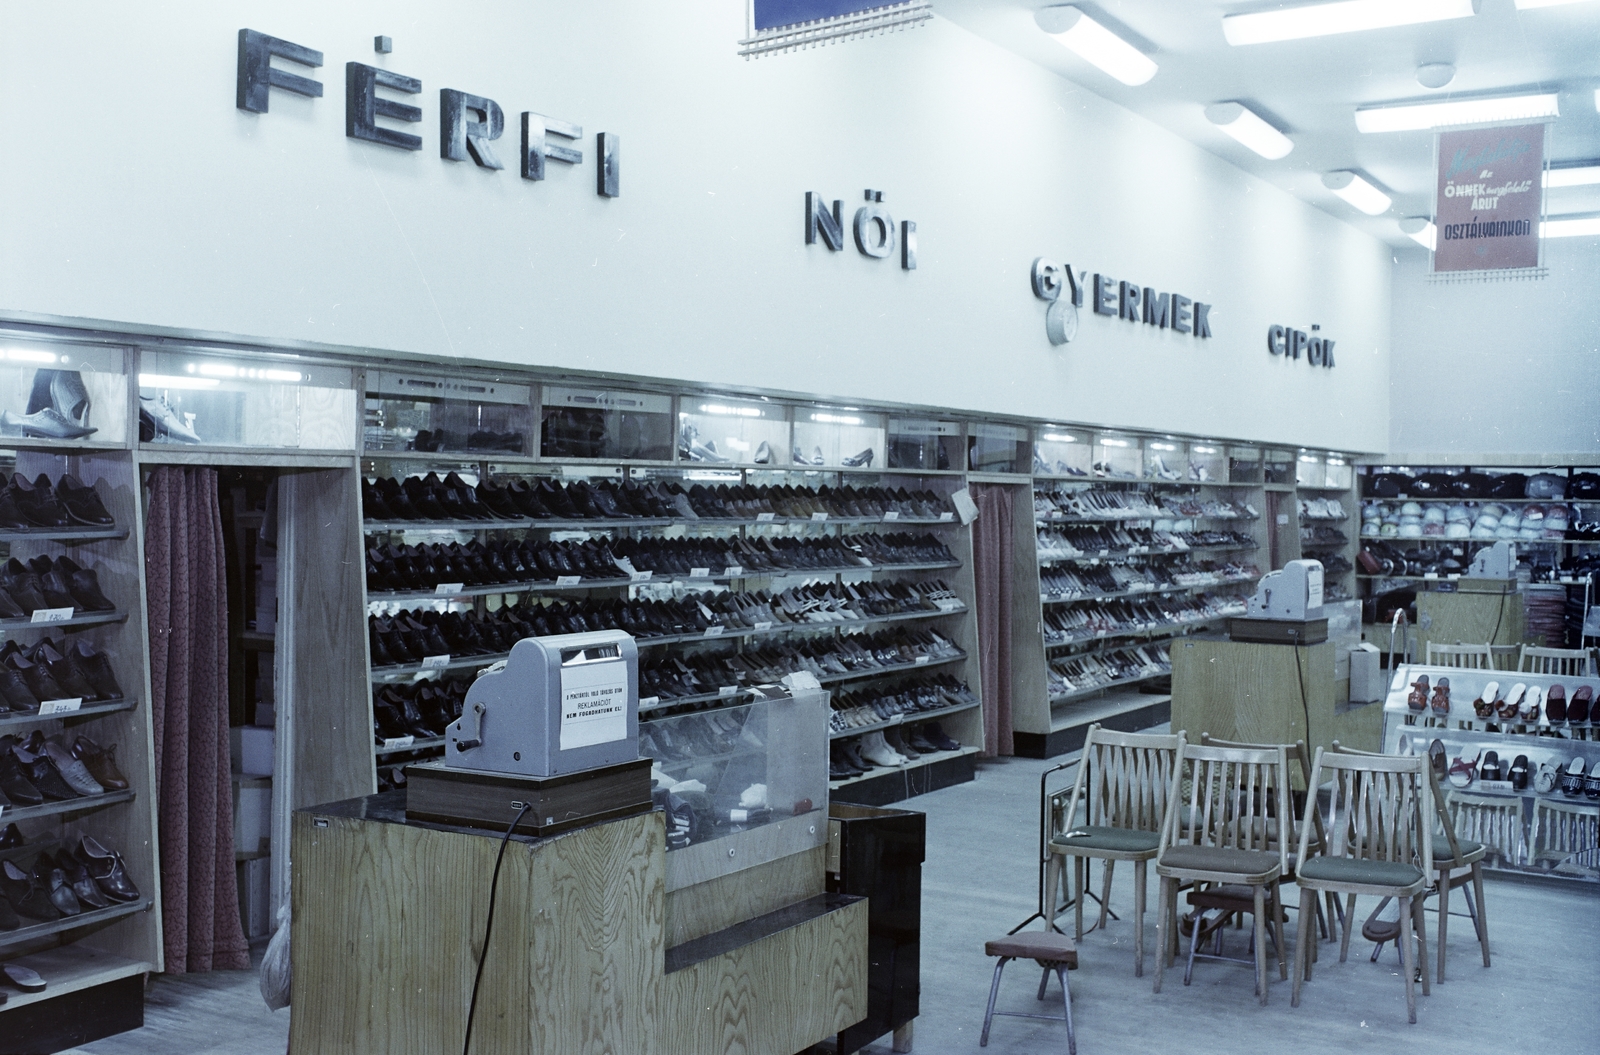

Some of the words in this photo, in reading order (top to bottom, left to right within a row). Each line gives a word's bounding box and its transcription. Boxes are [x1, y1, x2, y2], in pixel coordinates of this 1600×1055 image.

[236, 28, 620, 198] FÉRFI
[1030, 256, 1212, 339] GYERMEK
[1444, 181, 1486, 198] ÖNNEK
[1470, 193, 1500, 211] ÁRUT
[577, 698, 611, 709] REKLAMÁCIÓT
[579, 707, 612, 717] FOGADHATUNK
